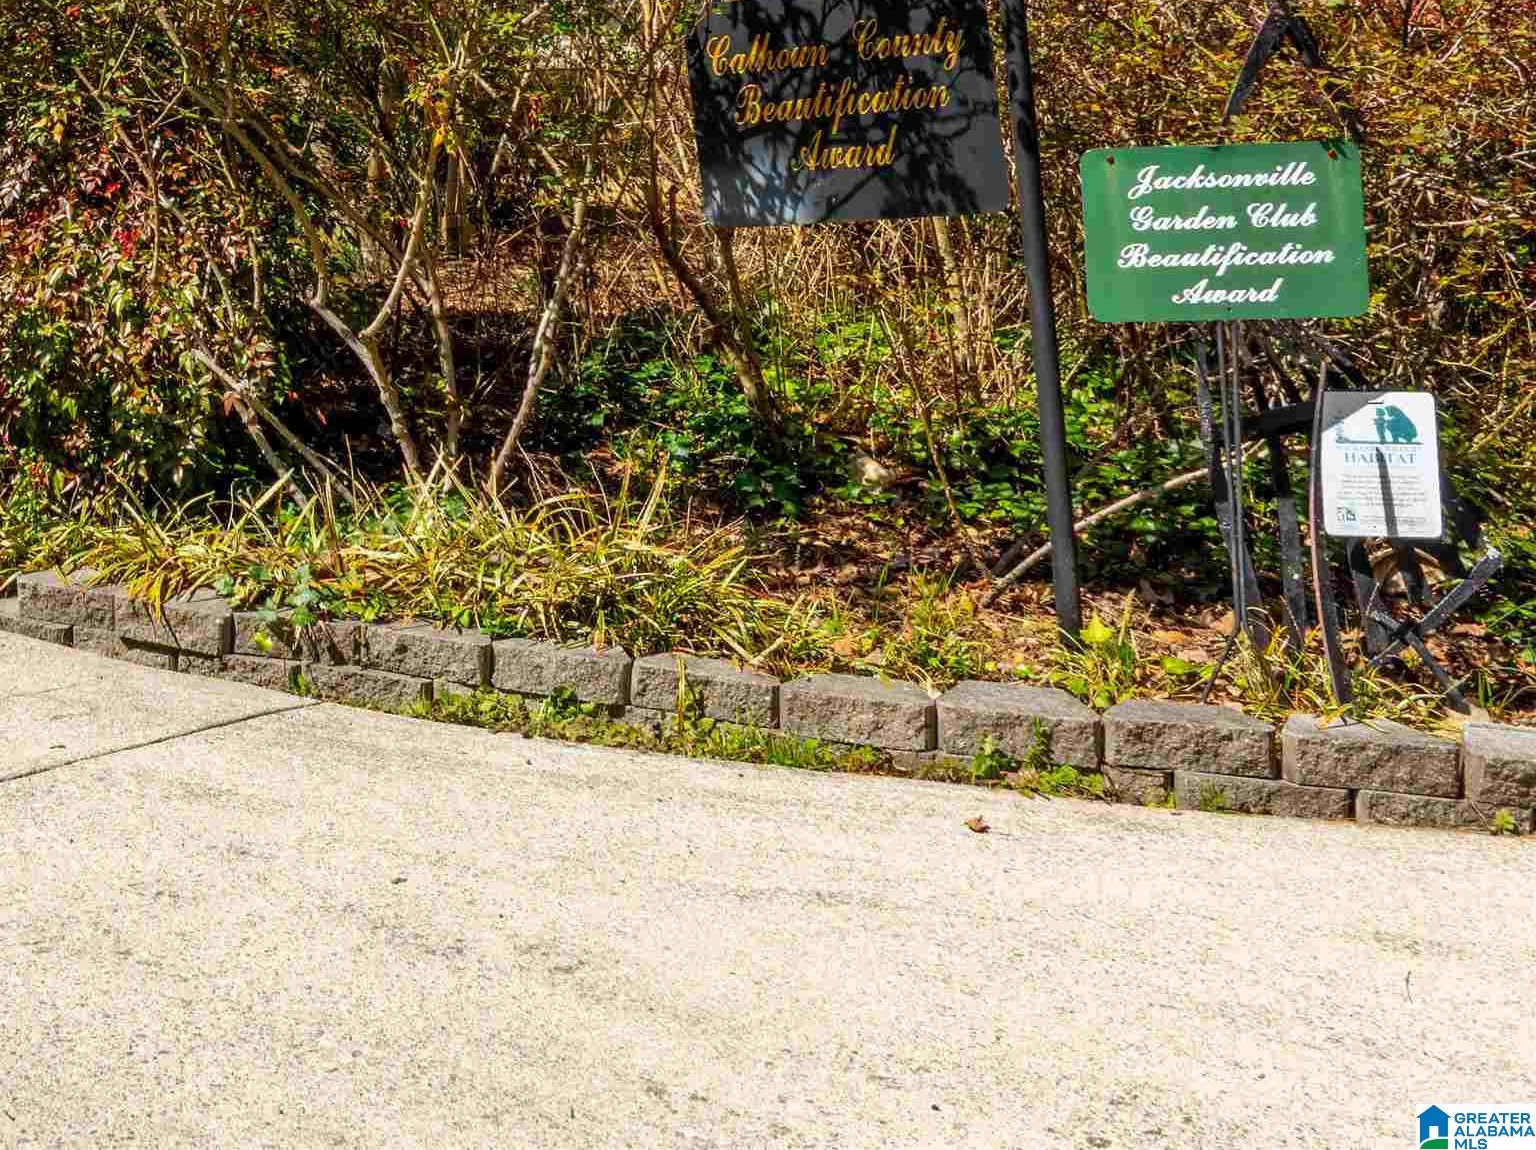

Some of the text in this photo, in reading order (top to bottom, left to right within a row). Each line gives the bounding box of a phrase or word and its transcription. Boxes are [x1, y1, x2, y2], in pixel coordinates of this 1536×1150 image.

[705, 17, 963, 77] Calhoun County
[735, 75, 950, 136] Beautification
[790, 125, 898, 172] Award
[1127, 161, 1316, 199] Jacksonville
[1129, 202, 1318, 231] Garden Club
[1117, 242, 1335, 276] Beautification
[1171, 277, 1284, 305] Award
